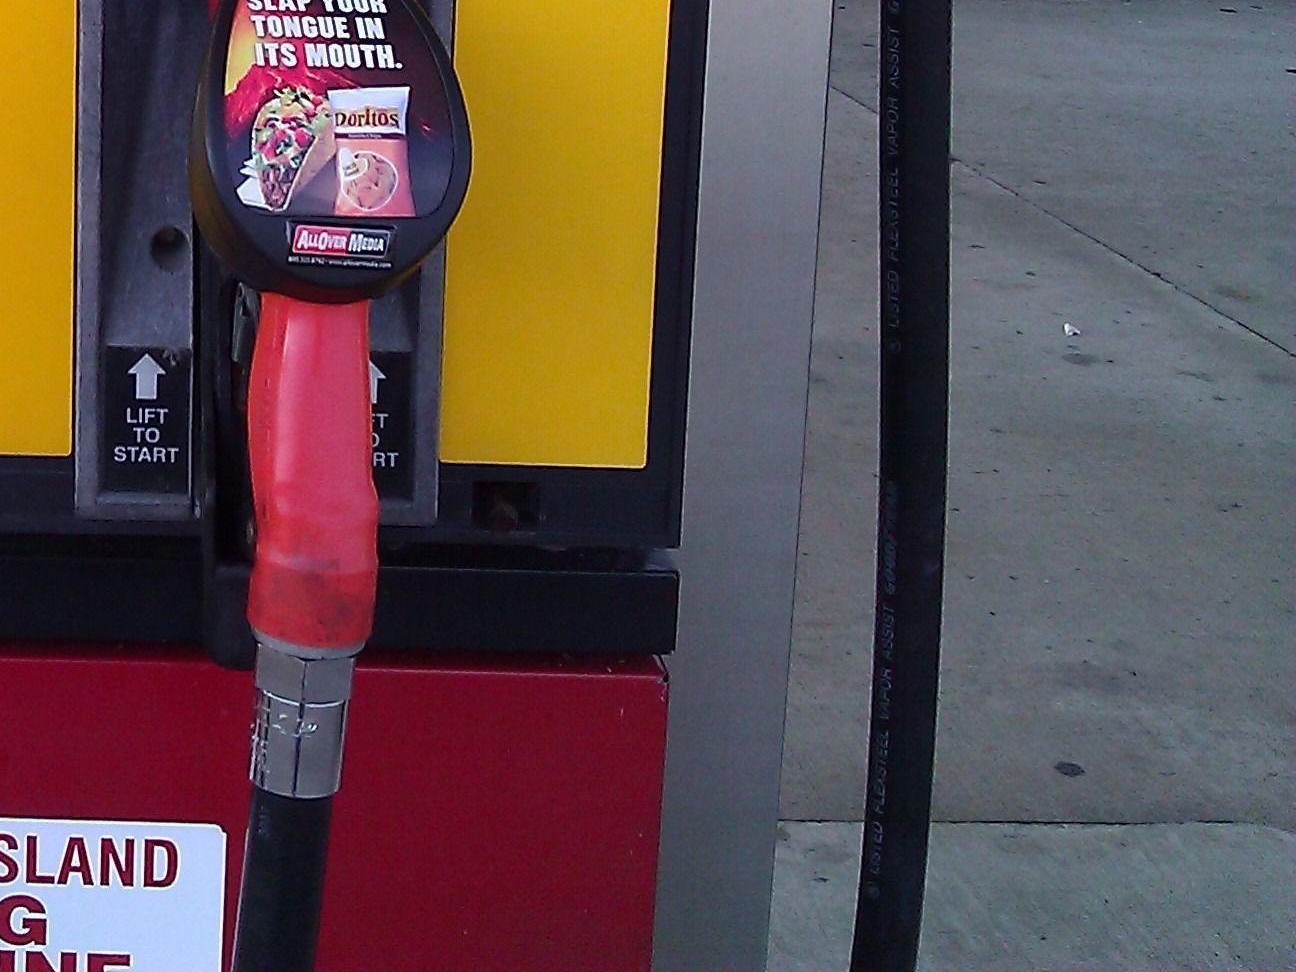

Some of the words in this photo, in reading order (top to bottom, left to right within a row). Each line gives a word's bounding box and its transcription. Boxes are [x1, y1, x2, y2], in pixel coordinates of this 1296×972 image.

[251, 15, 350, 40] TONGUE
[355, 17, 385, 39] IN
[255, 43, 298, 67] ITS
[305, 43, 403, 70] MOUTH.
[887, 23, 900, 88] ASSIST
[334, 108, 400, 129] Doritos
[886, 96, 900, 156] VAPOR
[886, 167, 900, 262] FLEXSTEEL
[127, 408, 168, 423] LIFT
[133, 428, 159, 442] TO
[114, 447, 179, 462] START
